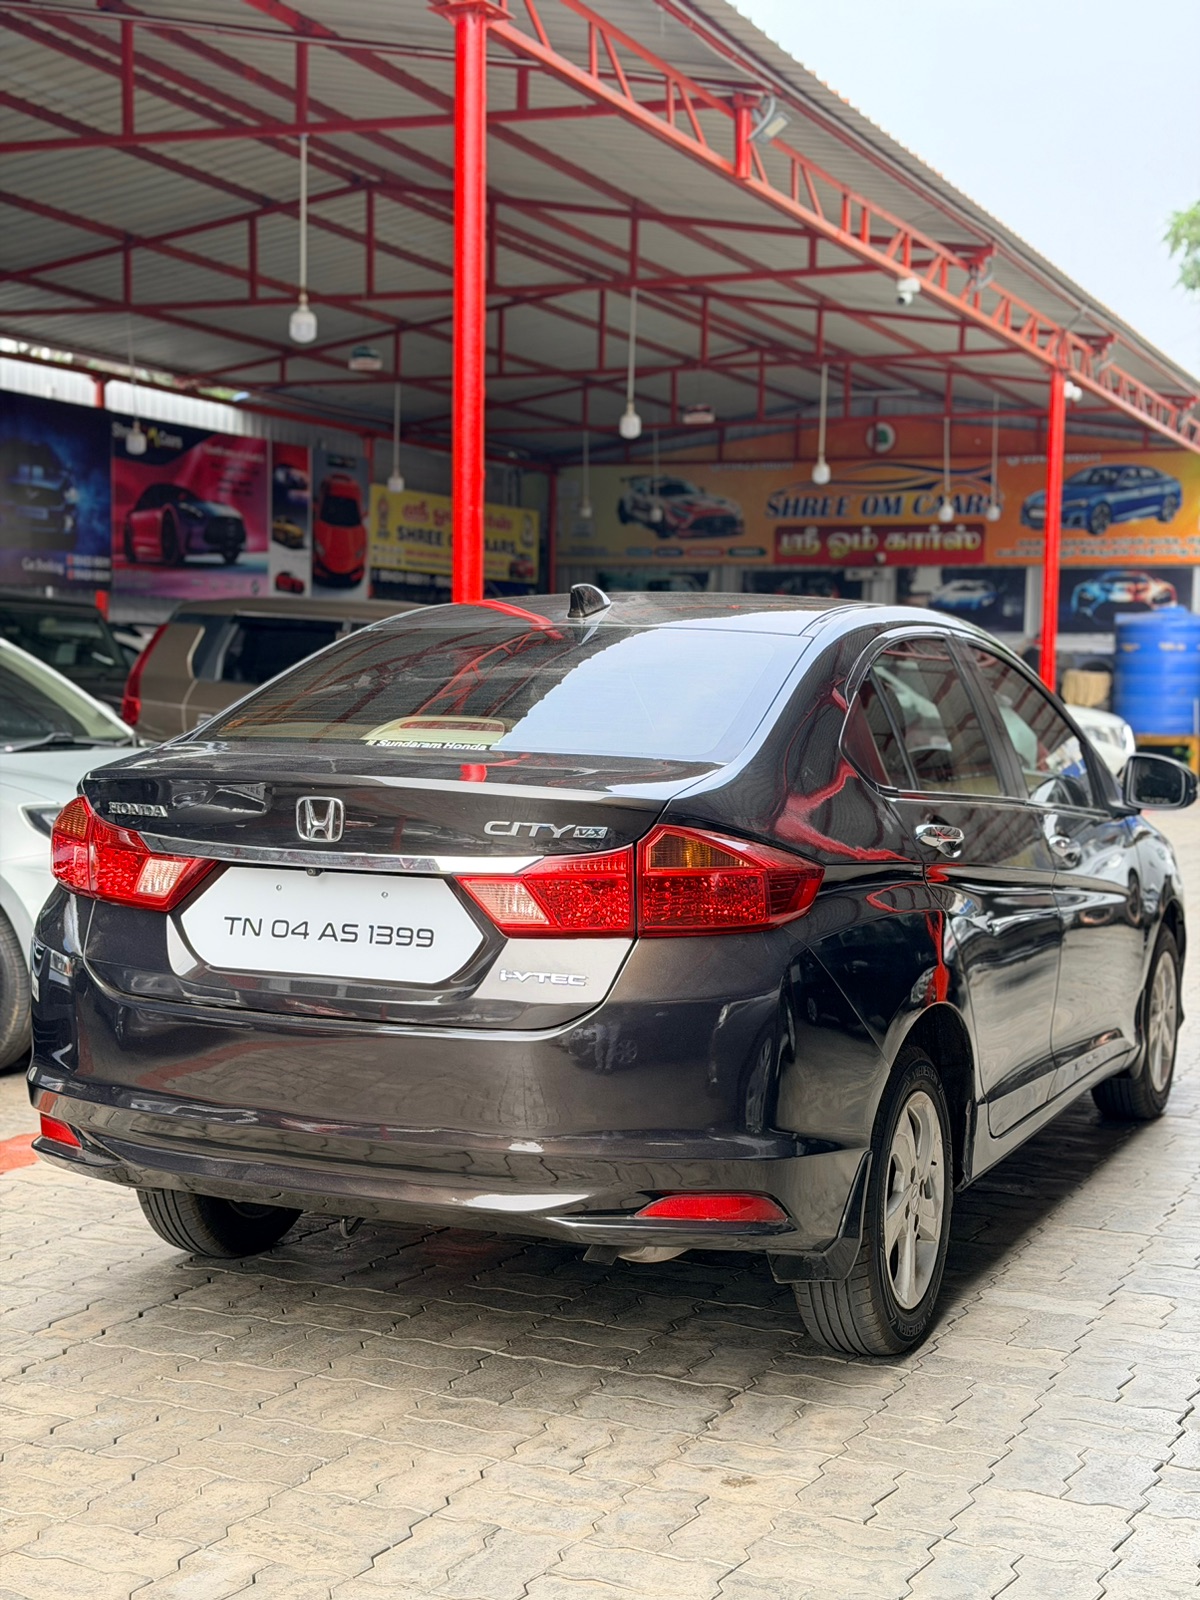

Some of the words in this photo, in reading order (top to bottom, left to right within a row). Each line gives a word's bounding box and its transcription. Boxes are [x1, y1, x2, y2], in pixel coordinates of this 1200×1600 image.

[766, 492, 850, 519] SHREE
[861, 495, 902, 518] OM
[397, 525, 443, 547] SHREE
[377, 739, 442, 749] Sundaram
[443, 742, 487, 751] Honda
[108, 801, 168, 818] HONDA
[483, 821, 576, 839] CITY
[574, 827, 607, 838] VX
[224, 916, 263, 937] TN
[271, 919, 309, 940] 04
[317, 922, 359, 943] AS
[368, 924, 435, 948] 1399
